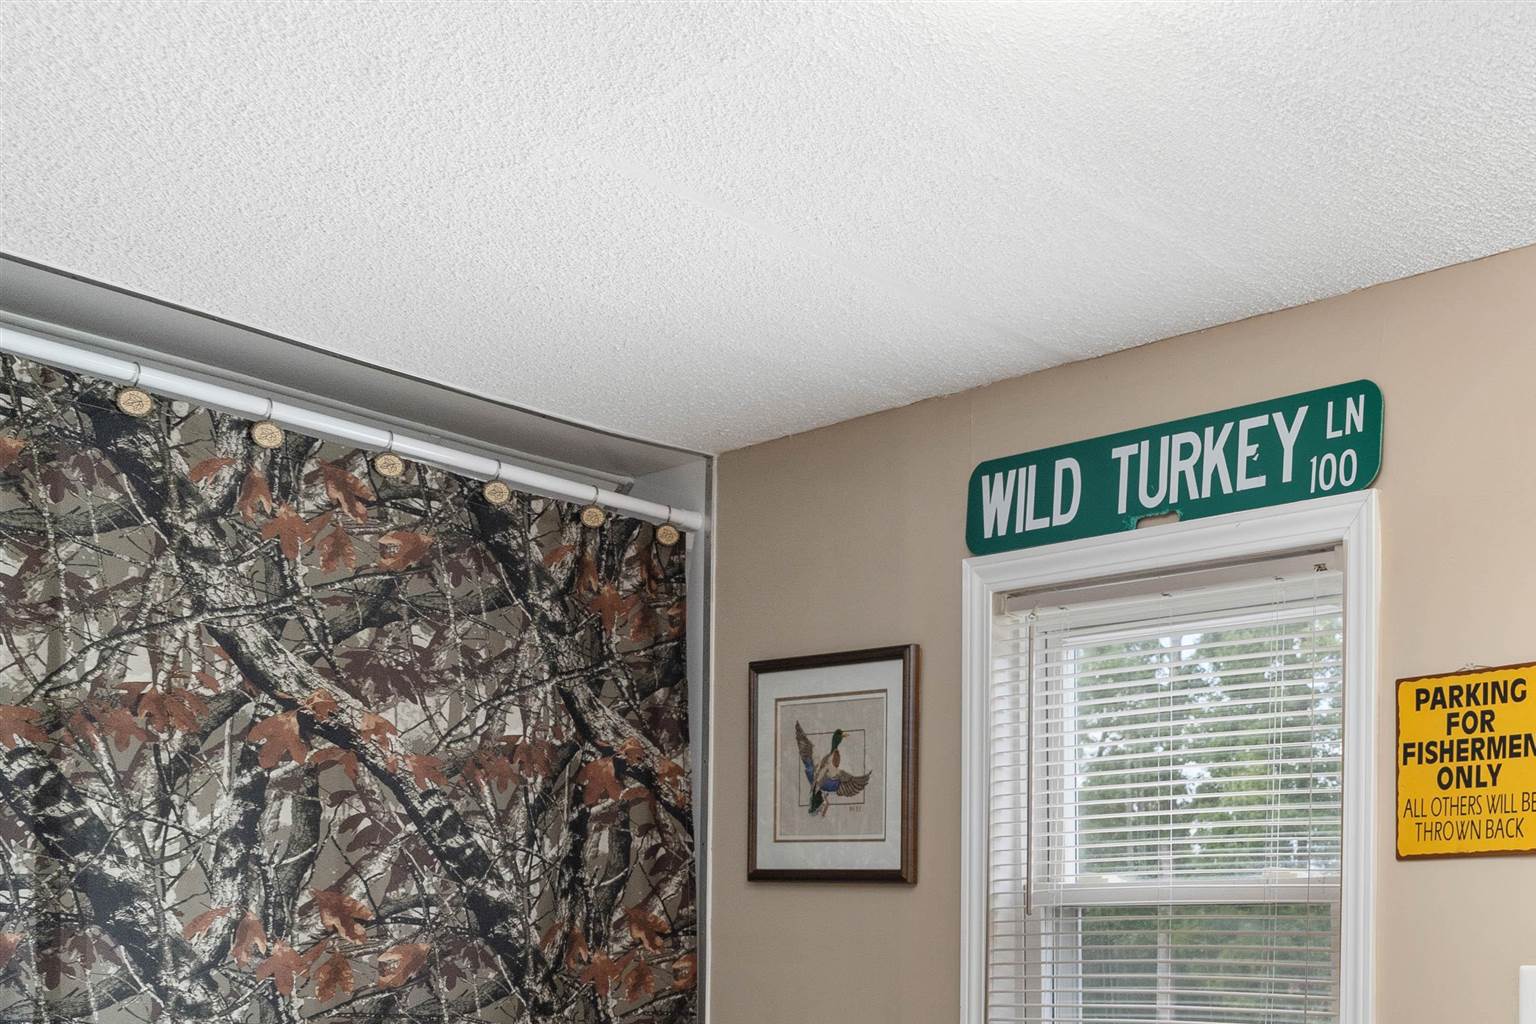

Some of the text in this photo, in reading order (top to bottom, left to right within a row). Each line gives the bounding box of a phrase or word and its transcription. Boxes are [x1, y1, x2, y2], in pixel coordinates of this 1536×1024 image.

[981, 394, 1365, 539] WILD TURKEY LN
[1310, 448, 1357, 493] 100
[1415, 678, 1527, 711] PARKING
[1446, 709, 1495, 735] FOR
[1437, 763, 1502, 790] ONLY
[1403, 798, 1427, 818] ALL
[1430, 795, 1483, 817] OTHERS
[1486, 793, 1517, 814] WILL
[1415, 817, 1524, 842] THROWN BACK
